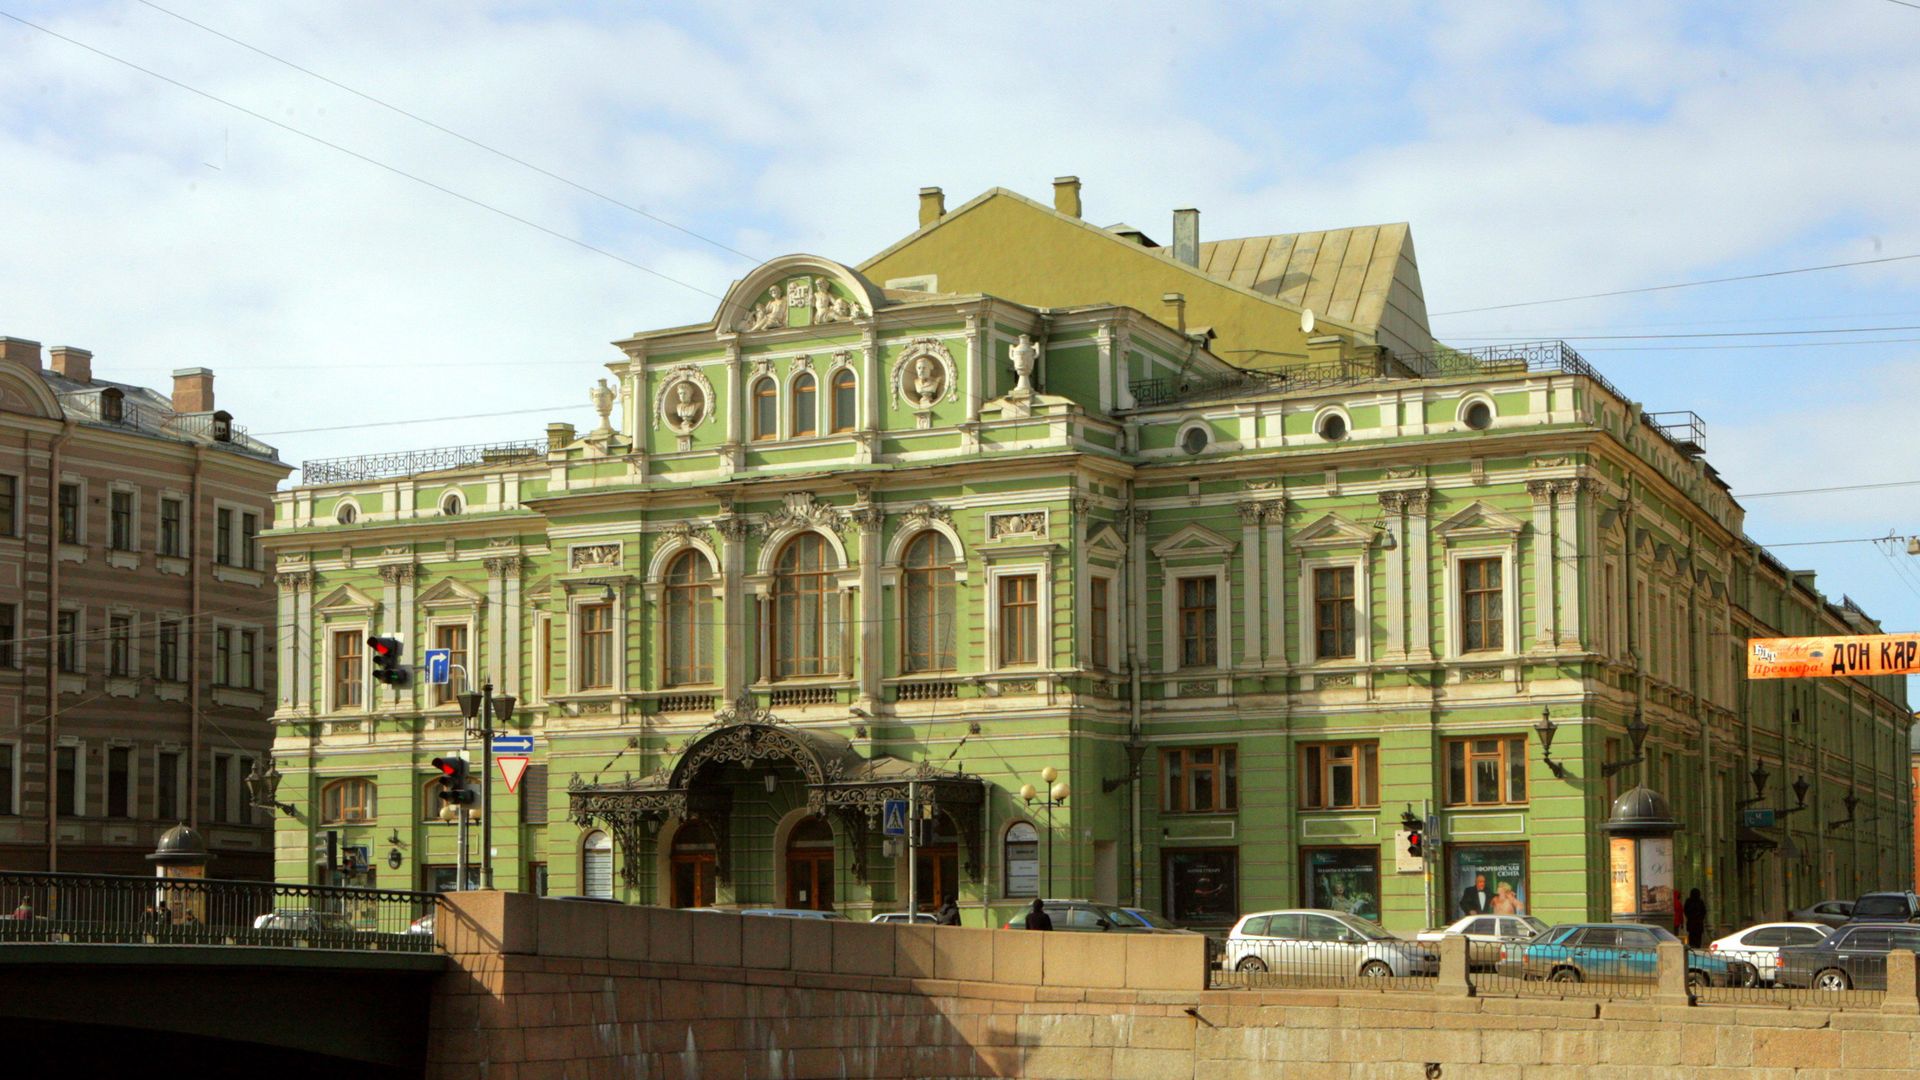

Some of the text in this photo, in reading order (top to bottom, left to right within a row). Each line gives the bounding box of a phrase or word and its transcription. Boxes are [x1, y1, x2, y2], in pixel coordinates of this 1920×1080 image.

[1753, 662, 1824, 677] Премьера!
[1831, 642, 1871, 675] ДОН
[1880, 640, 1918, 670] КАР
